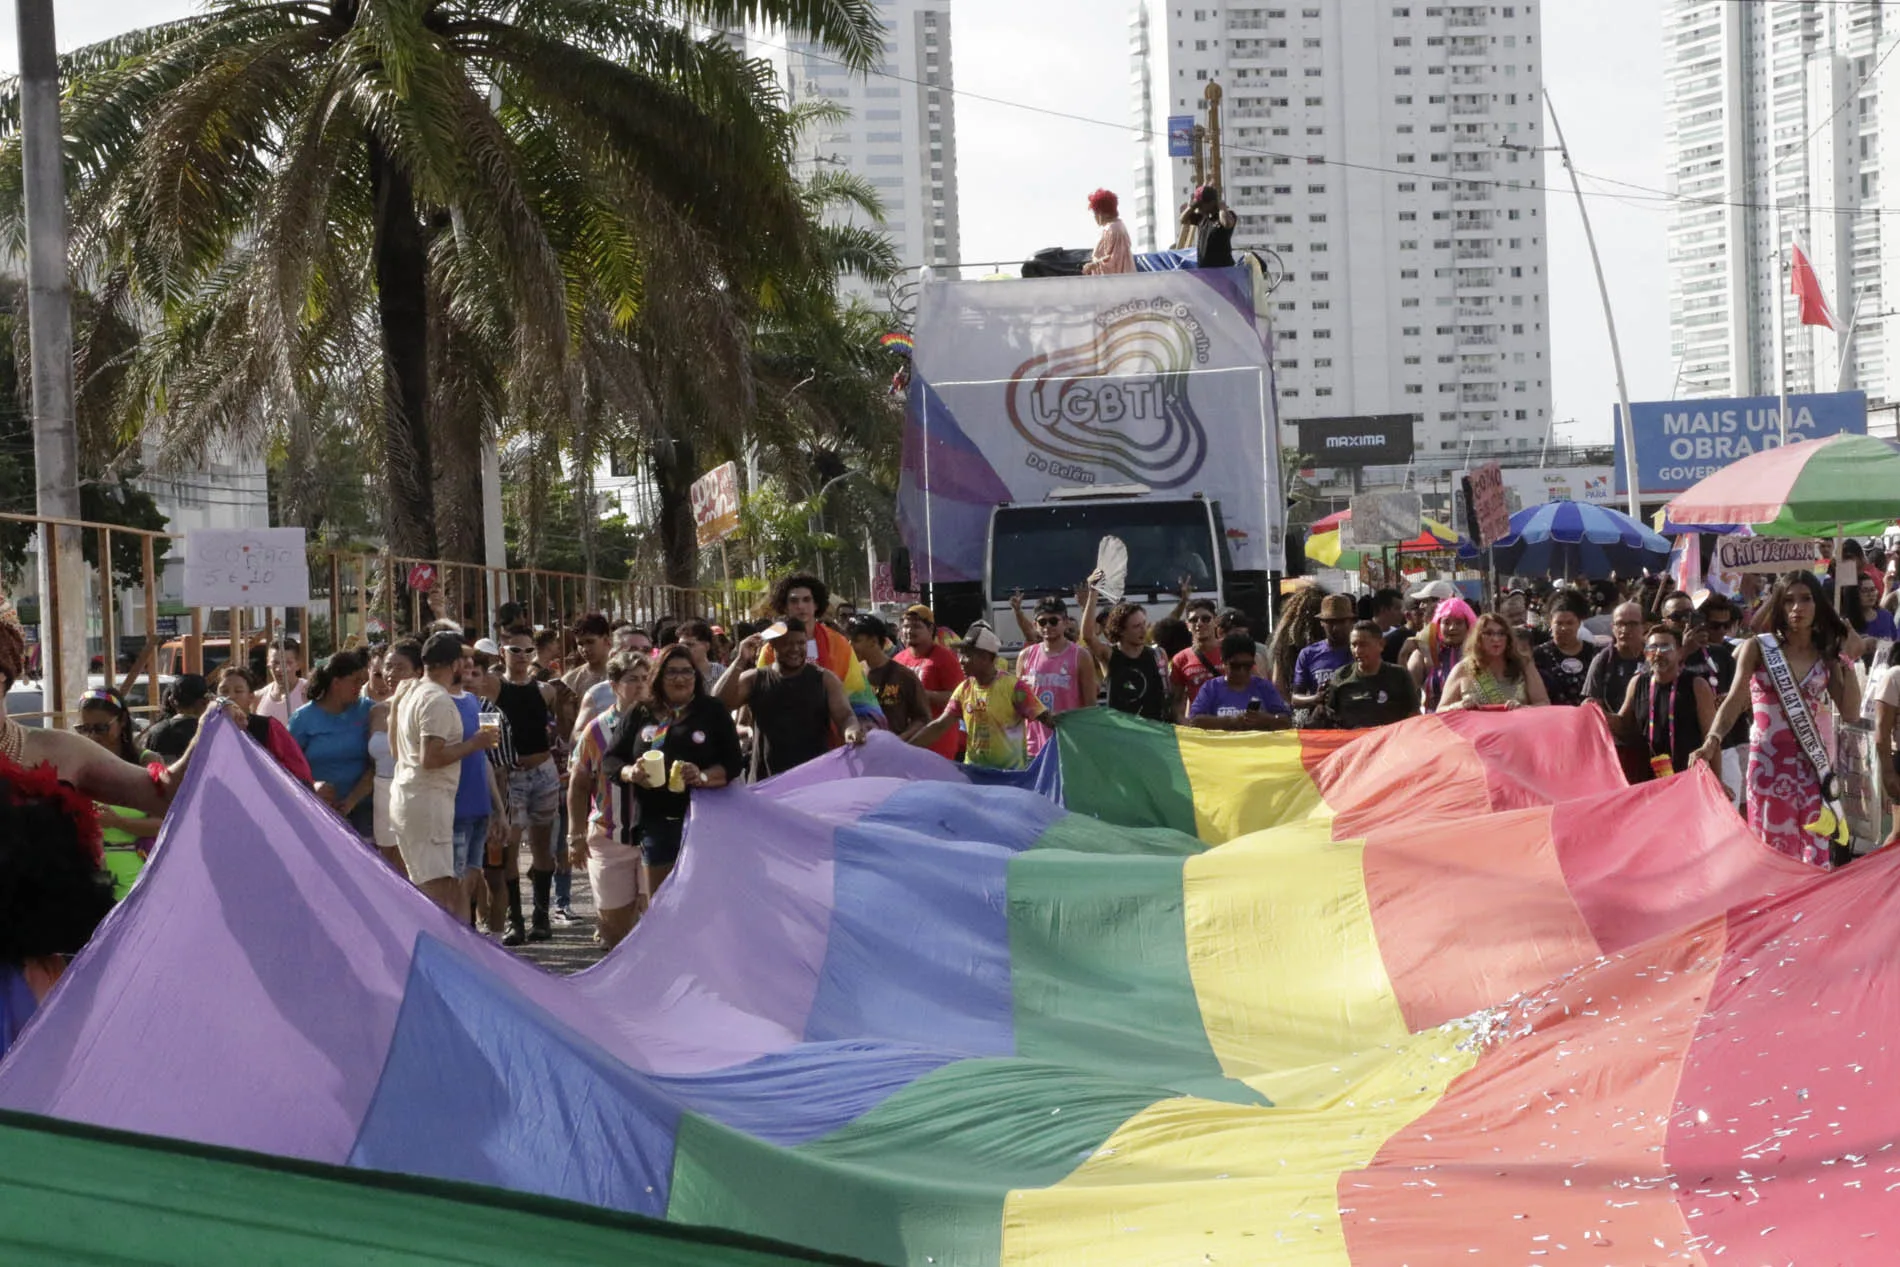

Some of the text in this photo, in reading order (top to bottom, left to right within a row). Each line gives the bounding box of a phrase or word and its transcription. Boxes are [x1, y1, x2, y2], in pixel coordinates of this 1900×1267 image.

[1151, 296, 1173, 313] do
[1663, 406, 1816, 435] MAIS UMA
[1325, 434, 1386, 448] MAXIMA
[1669, 435, 1753, 460] OBRA
[1025, 452, 1047, 472] De
[1658, 465, 1722, 481] GOVER
[1764, 645, 1783, 669] MISS
[1771, 664, 1792, 694] BELEZA
[1783, 691, 1802, 710] GAY
[1791, 710, 1819, 751] TOCANTINS
